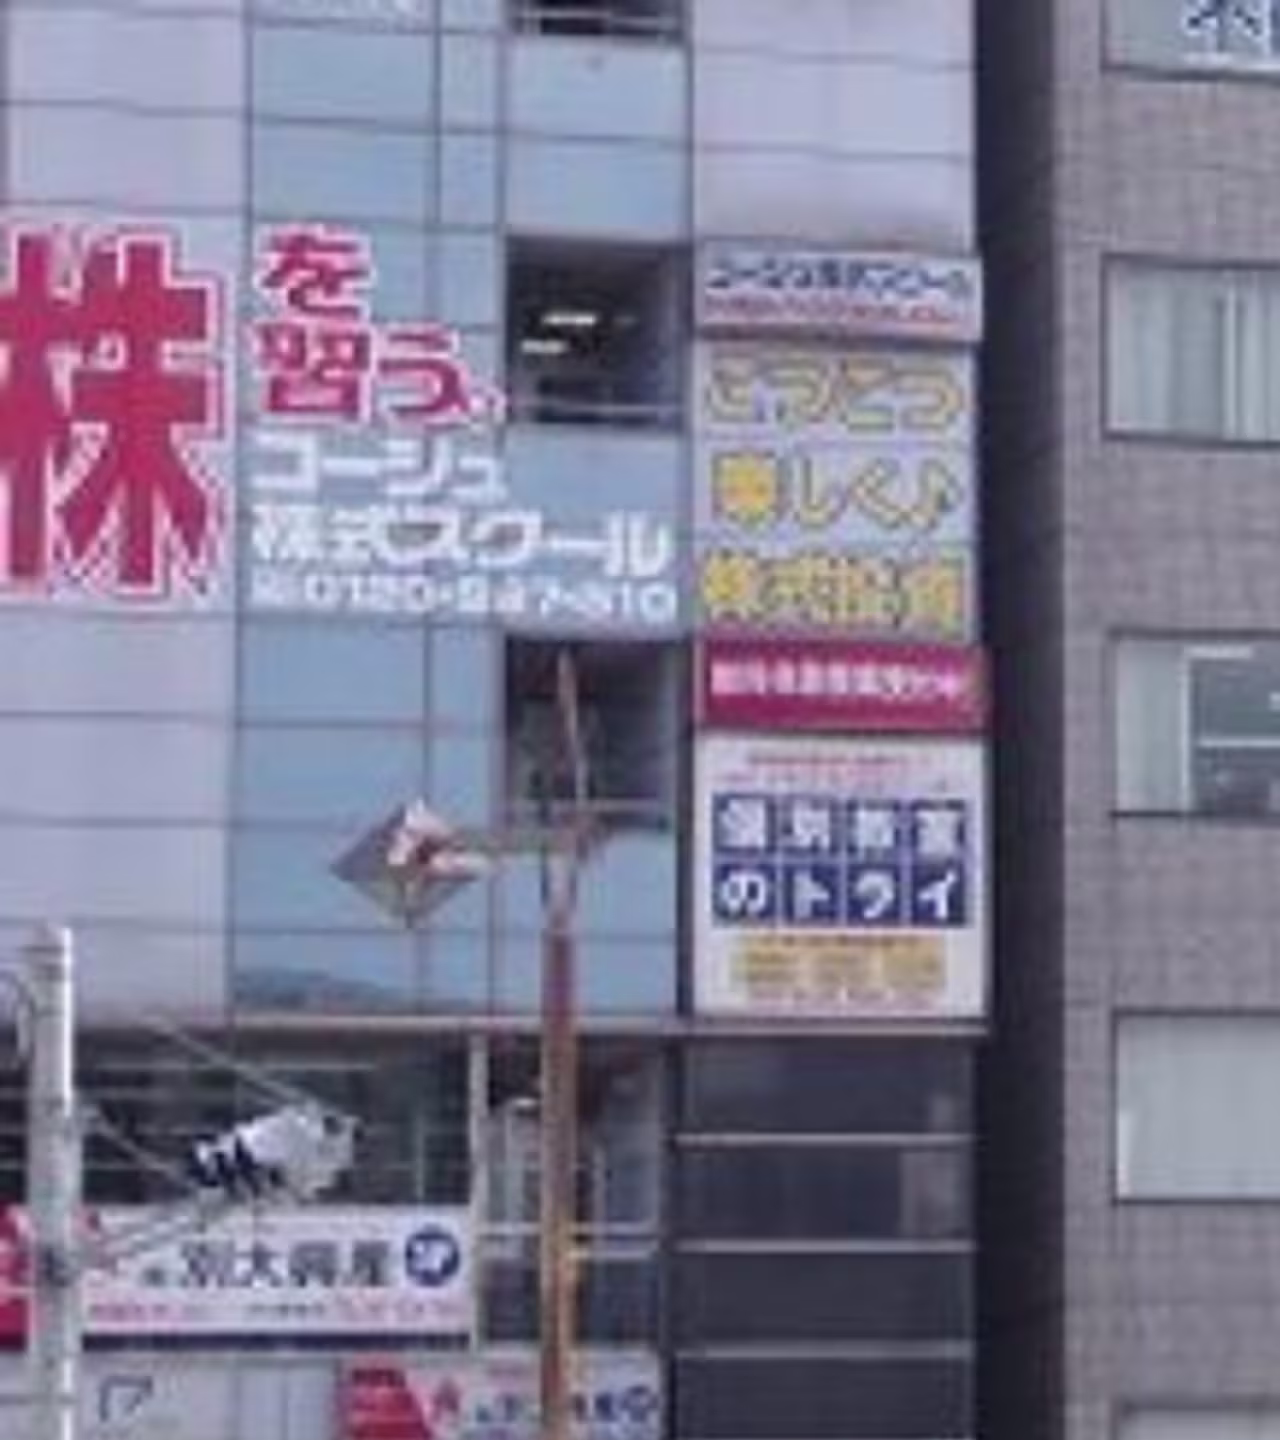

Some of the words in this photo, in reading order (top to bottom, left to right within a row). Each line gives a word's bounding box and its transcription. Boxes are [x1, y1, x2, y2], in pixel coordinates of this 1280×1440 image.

[255, 228, 374, 320] を
[0, 228, 226, 598] 株
[718, 866, 964, 924] のトライ
